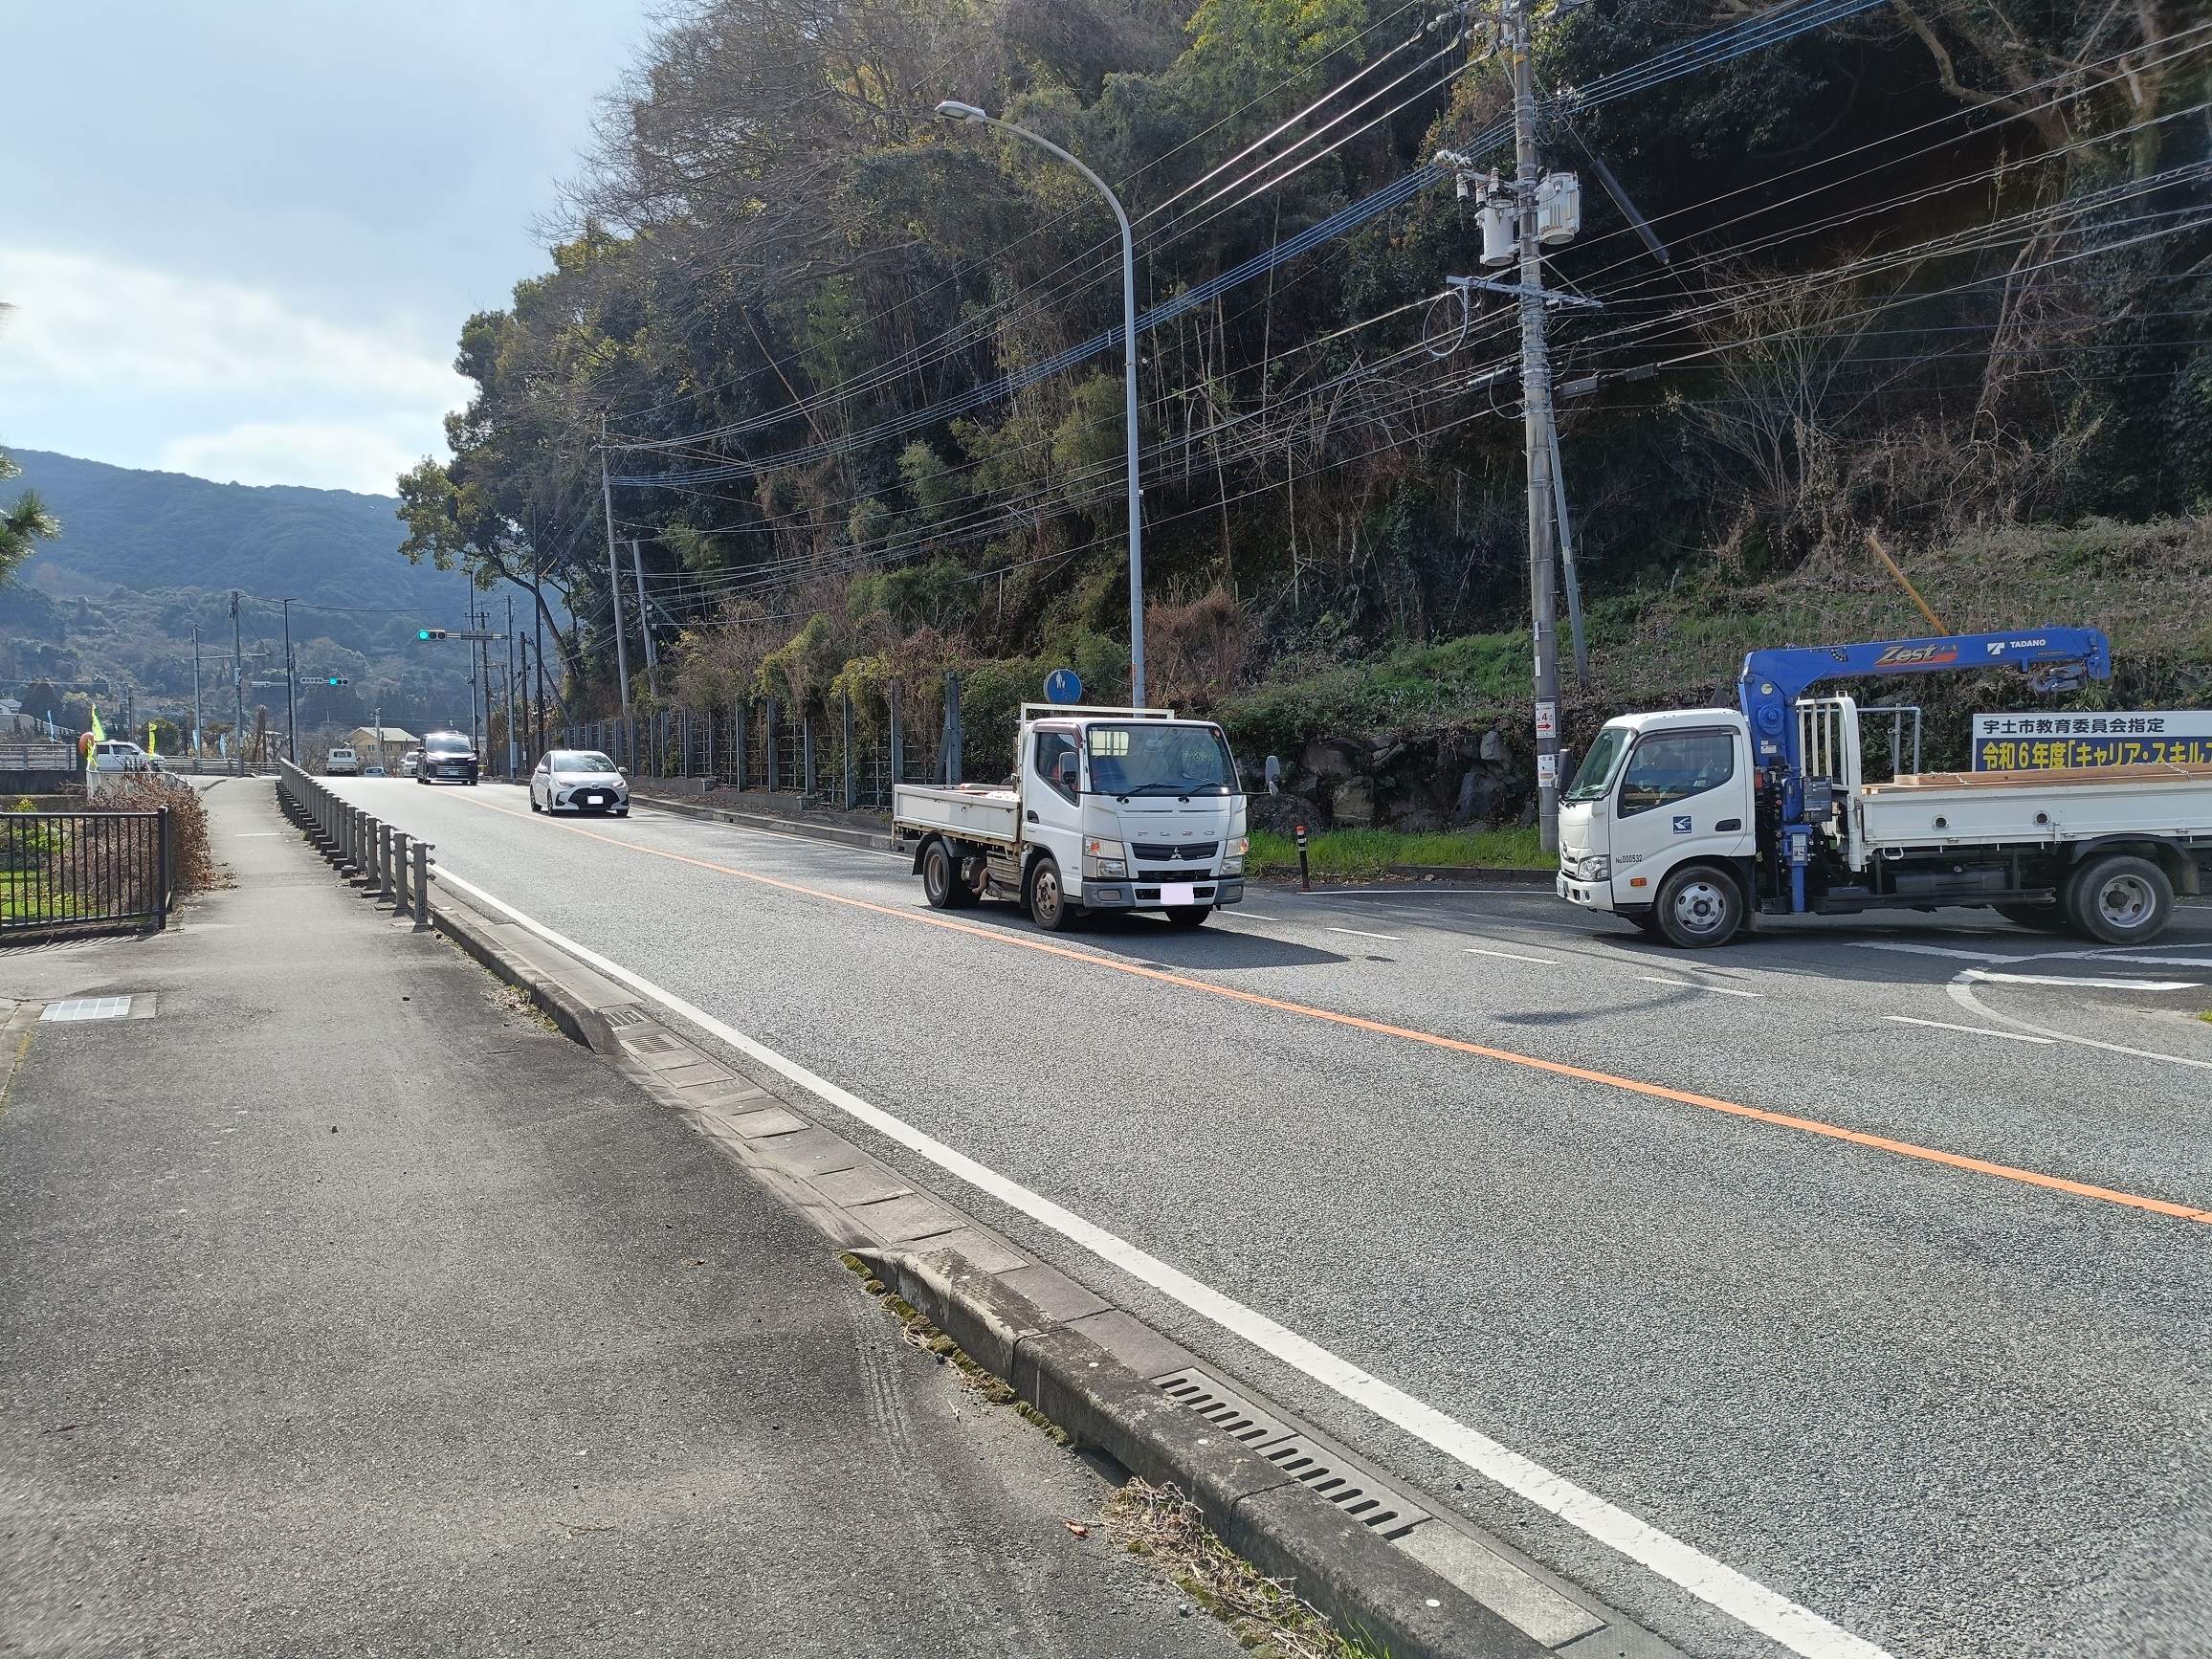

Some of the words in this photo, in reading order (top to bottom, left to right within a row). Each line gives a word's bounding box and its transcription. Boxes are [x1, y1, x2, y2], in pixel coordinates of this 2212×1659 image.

[2010, 639, 2046, 648] TADANO
[1874, 644, 1938, 665] Zest
[1982, 719, 2165, 734] 宇土市教育委員会指定
